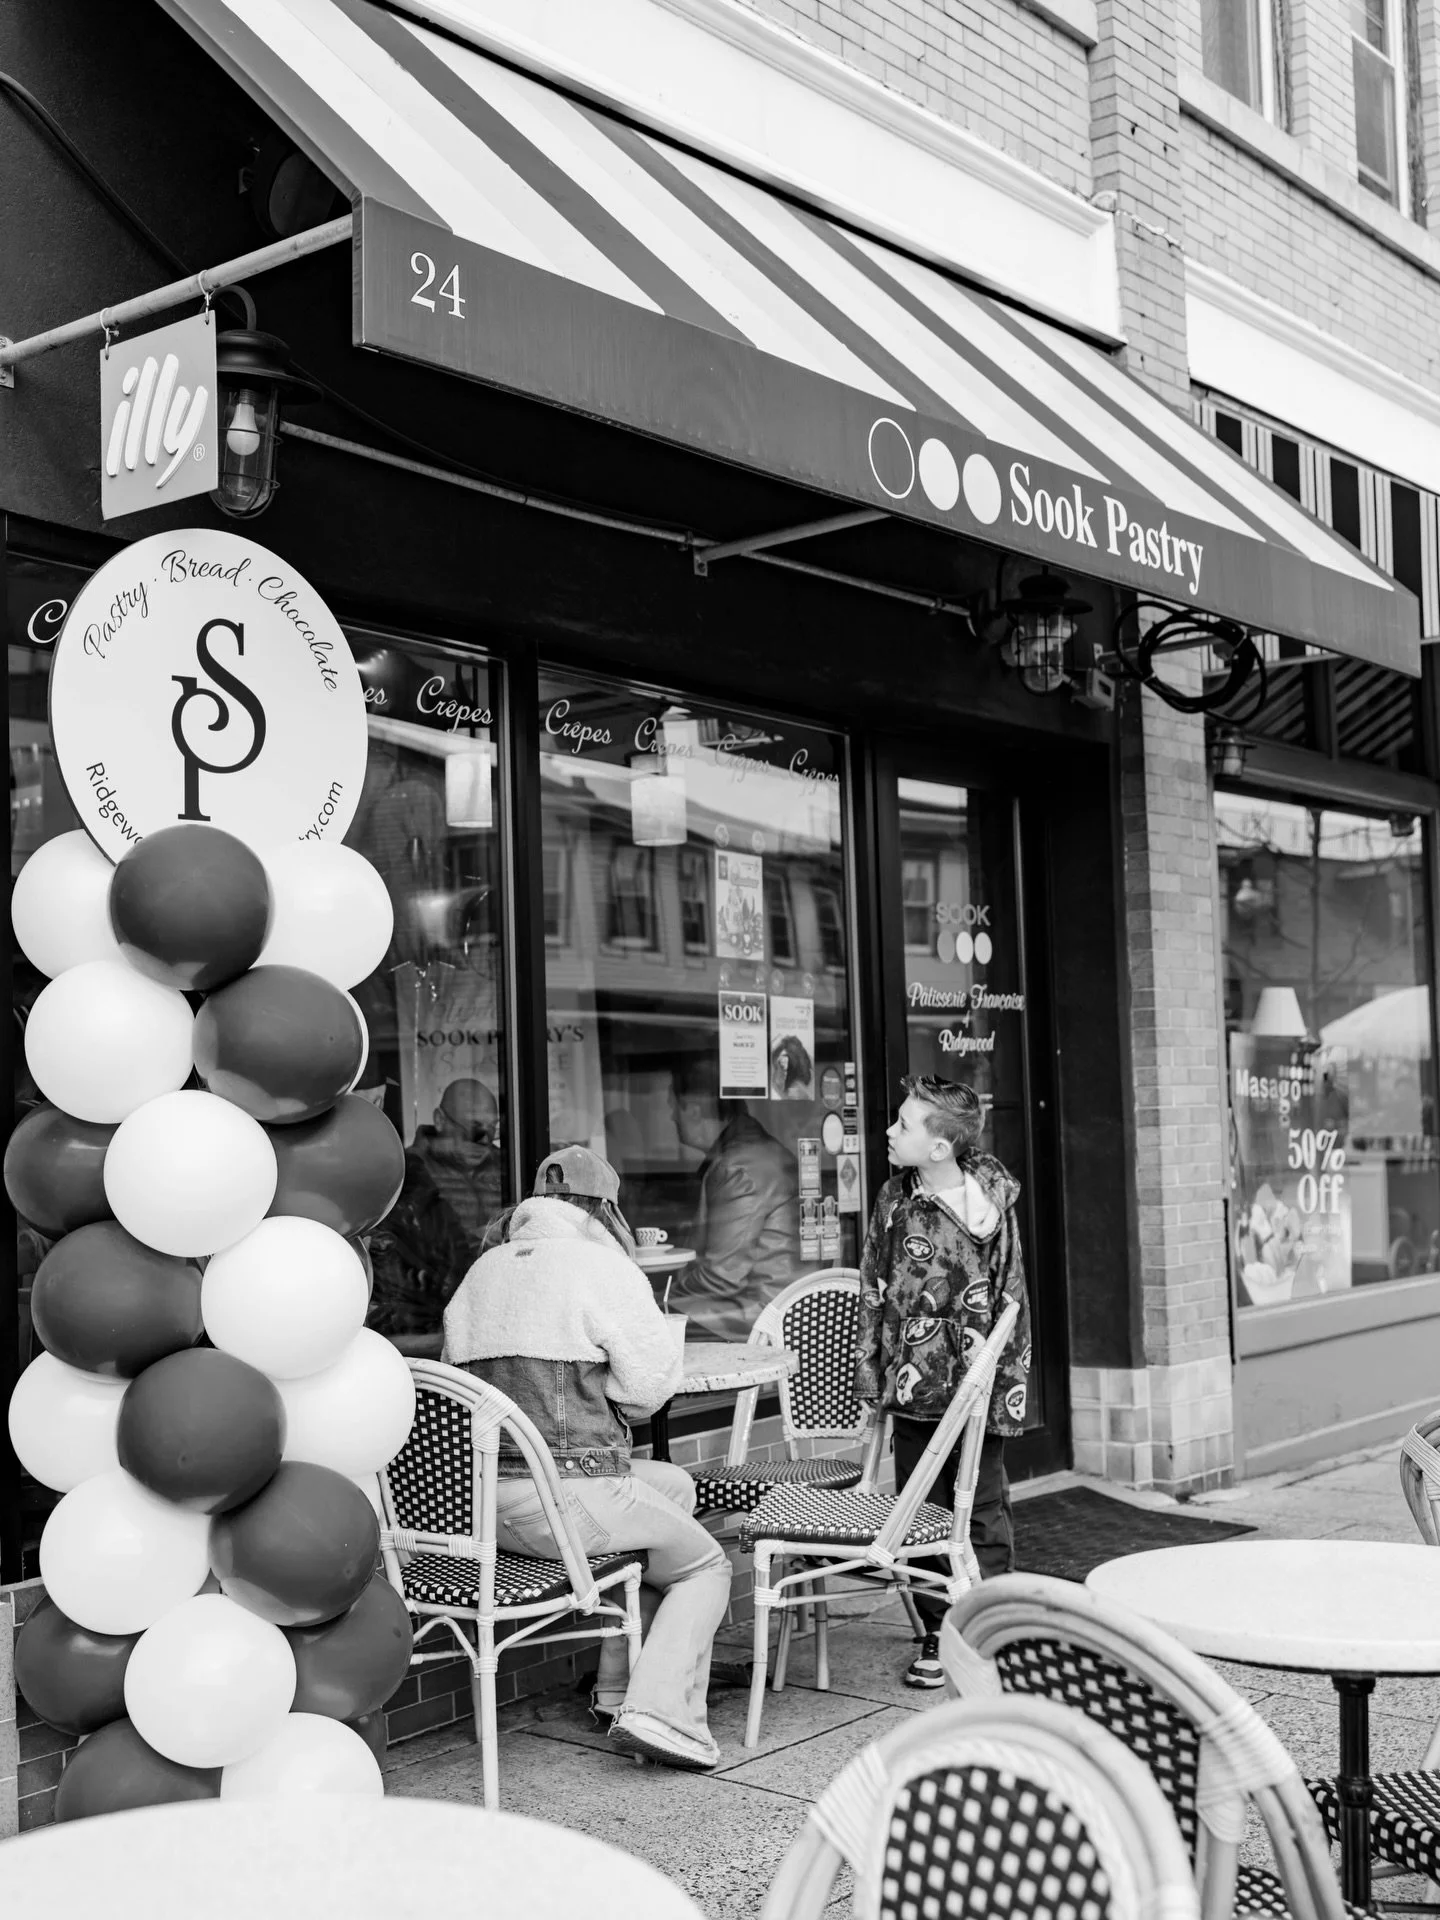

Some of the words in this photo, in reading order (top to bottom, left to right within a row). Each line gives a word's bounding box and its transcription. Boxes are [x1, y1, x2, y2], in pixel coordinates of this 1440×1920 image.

[410, 252, 466, 319] 24
[106, 353, 208, 488] illy
[1010, 462, 1098, 549] Sook
[1103, 495, 1204, 596] Pastry
[83, 581, 148, 659] Pastry
[161, 549, 252, 588] Bread
[257, 576, 339, 692] Chocolate
[416, 675, 493, 734] Crêpes
[545, 699, 612, 754] Crêpes
[935, 904, 991, 927] SOOK
[725, 1004, 762, 1022] SOOK
[417, 1029, 480, 1048] SOOK
[938, 1029, 995, 1057] Ridgewood
[1288, 1128, 1346, 1171] 50%
[1298, 1173, 1344, 1214] Off
